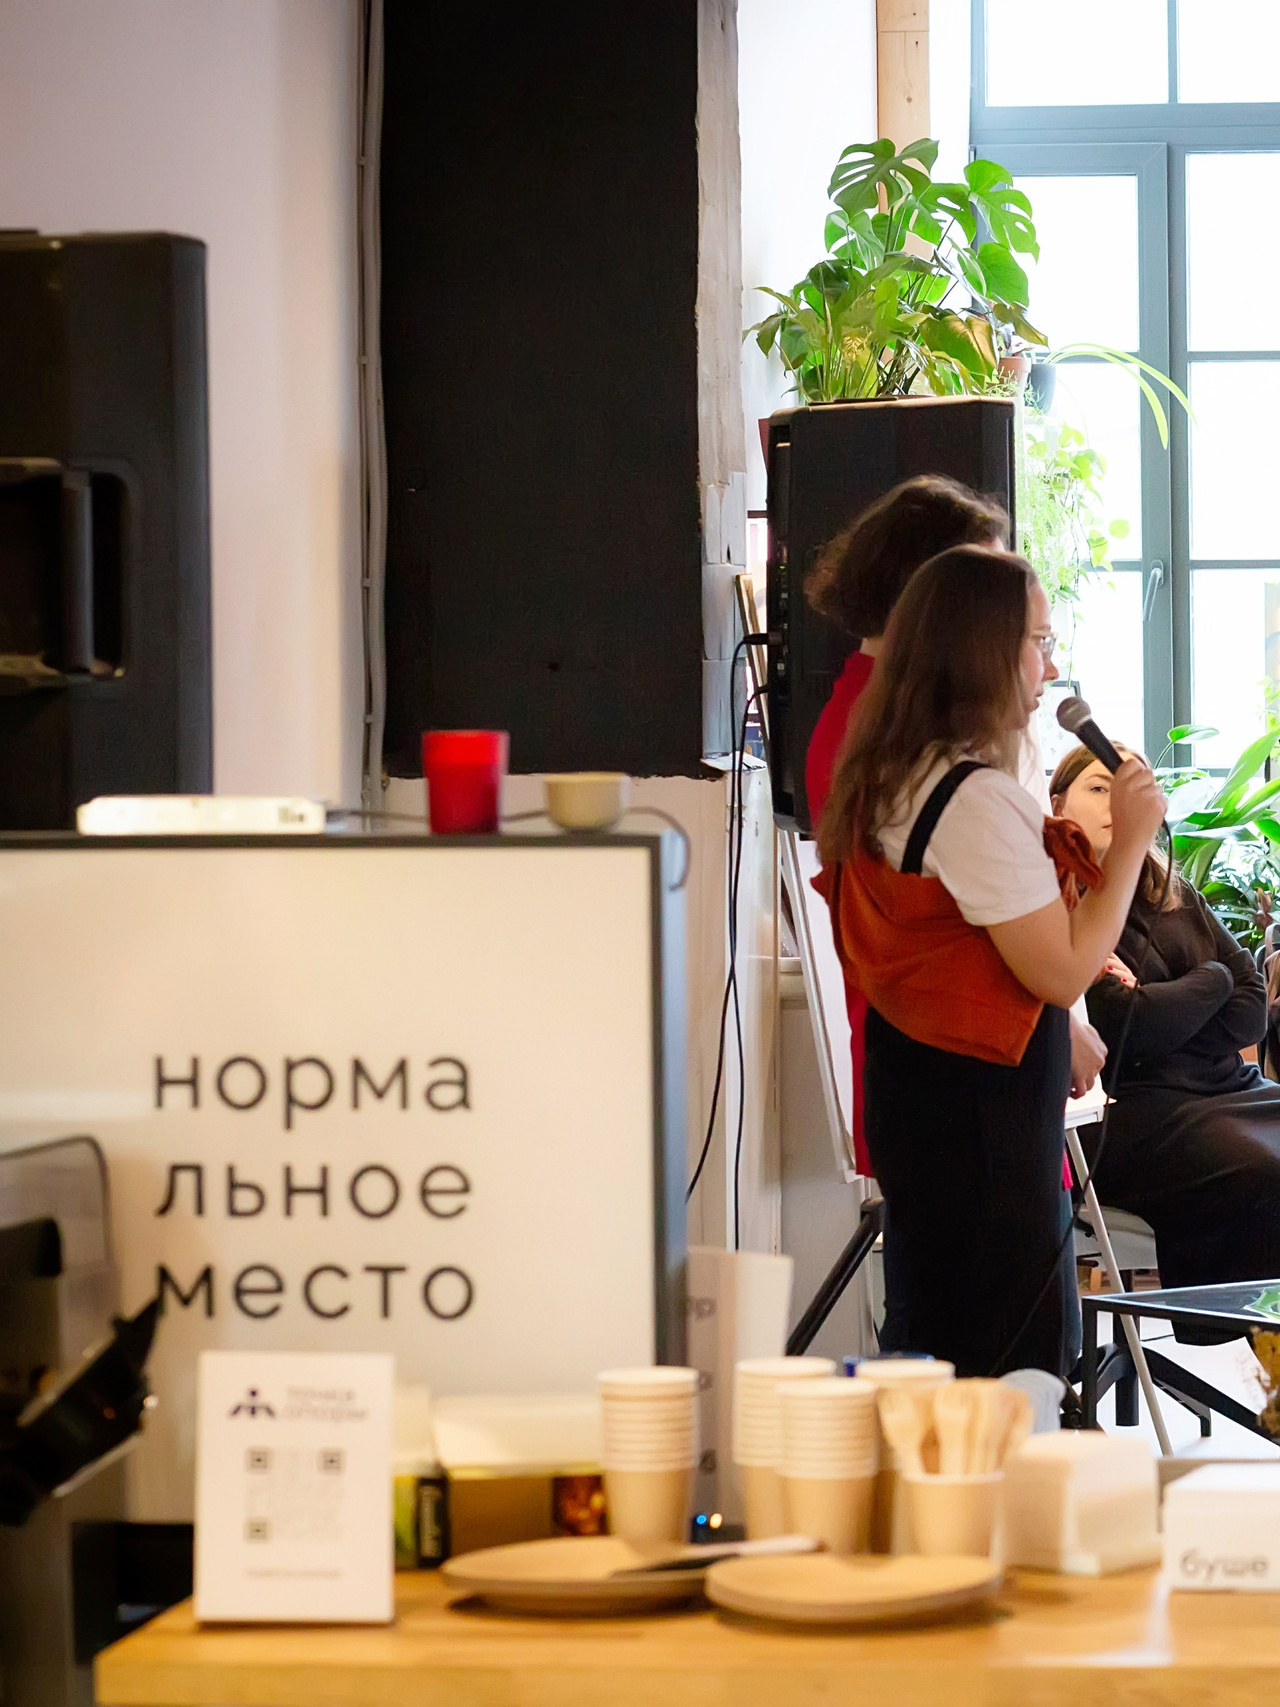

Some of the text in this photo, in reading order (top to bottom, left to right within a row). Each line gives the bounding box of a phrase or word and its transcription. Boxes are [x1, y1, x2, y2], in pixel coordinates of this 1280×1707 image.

[155, 1056, 472, 1131] норма
[154, 1164, 471, 1219] льное
[156, 1264, 474, 1320] место
[1181, 1548, 1270, 1584] буше
